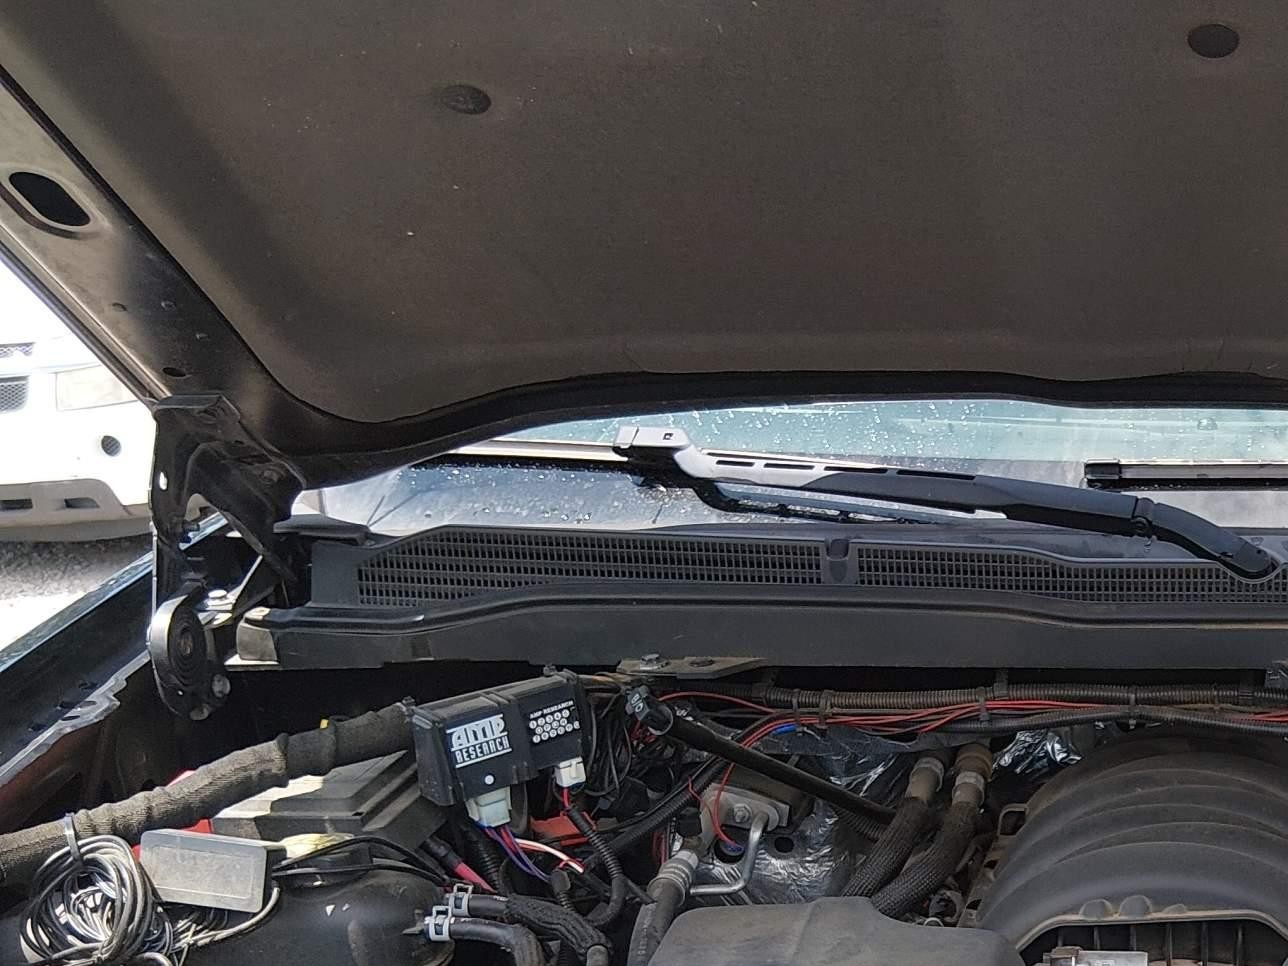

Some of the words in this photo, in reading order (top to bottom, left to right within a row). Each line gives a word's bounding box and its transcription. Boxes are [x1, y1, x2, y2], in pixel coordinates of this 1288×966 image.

[543, 700, 574, 714] RESEARCH
[451, 716, 506, 749] AMP
[455, 735, 510, 764] RESEARCH
